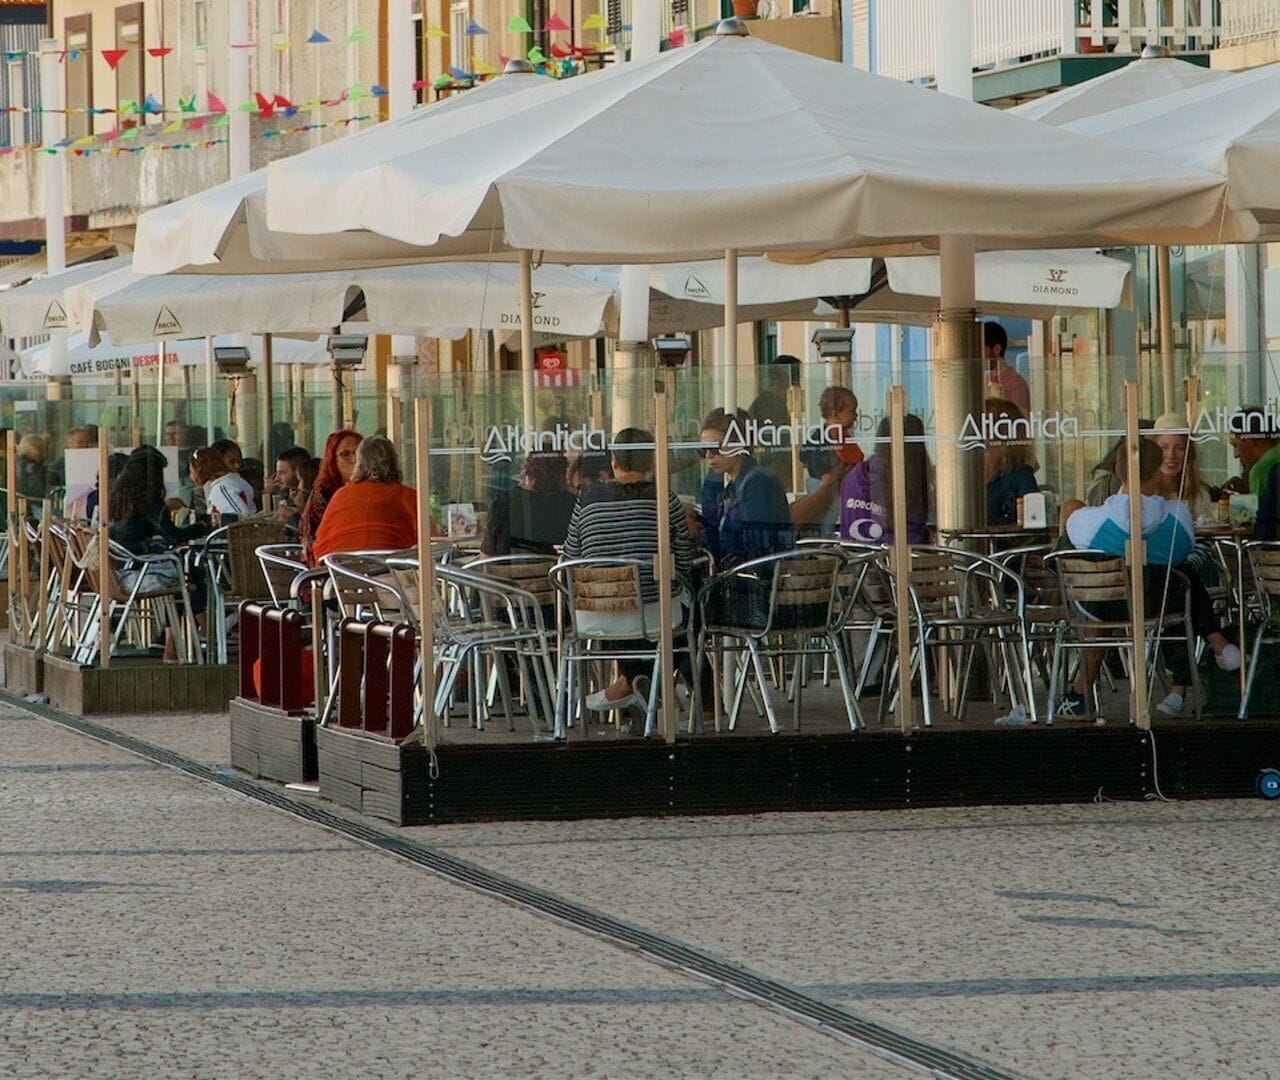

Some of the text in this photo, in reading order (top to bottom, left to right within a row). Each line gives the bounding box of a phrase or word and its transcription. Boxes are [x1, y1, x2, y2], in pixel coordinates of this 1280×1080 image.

[1033, 285, 1079, 295] DIAMOND
[501, 314, 560, 326] DIAOND
[70, 353, 179, 373] CAFÉ BOGANI DESPRTA
[722, 419, 843, 447] Atlântida
[959, 411, 1078, 440] Atlântida
